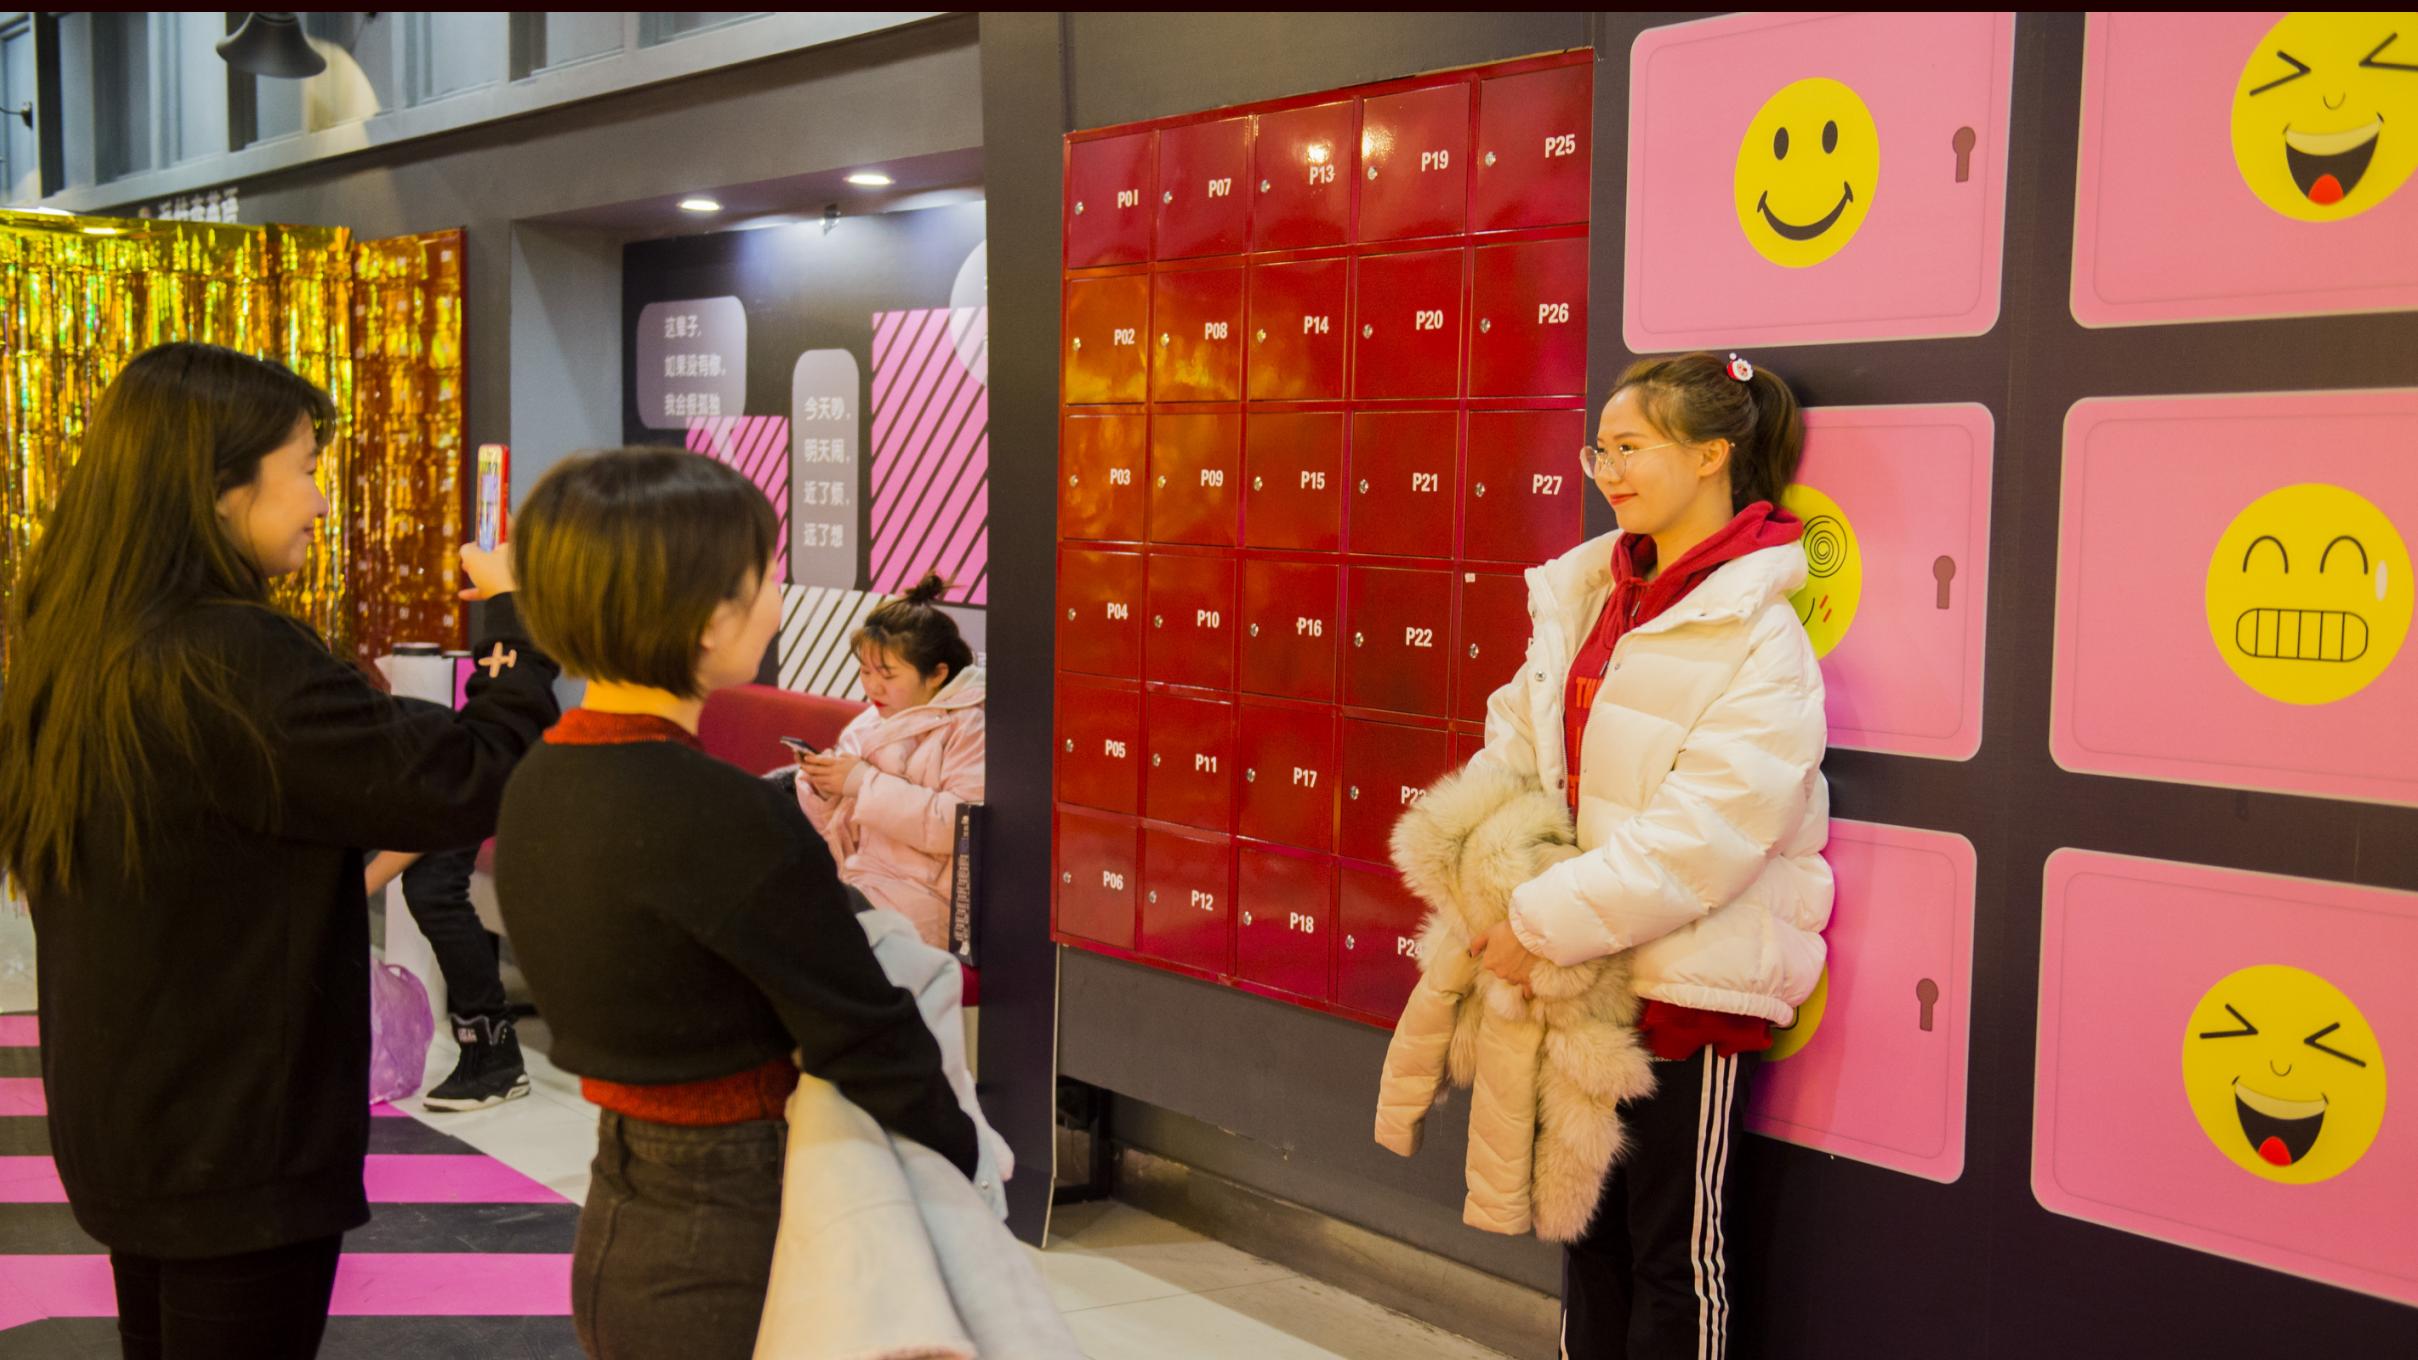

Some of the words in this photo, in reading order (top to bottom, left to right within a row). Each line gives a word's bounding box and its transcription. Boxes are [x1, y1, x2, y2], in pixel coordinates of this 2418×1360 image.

[1544, 133, 1576, 159] P25
[1421, 149, 1449, 172] P19
[1308, 163, 1337, 186] P13
[1208, 177, 1232, 198] P07
[1415, 309, 1444, 331] P20
[1538, 302, 1570, 325] P26
[1204, 321, 1228, 340] P08
[1303, 315, 1330, 335] P14
[1113, 327, 1136, 346] P02
[1109, 467, 1131, 486] P03
[1200, 468, 1224, 487] P09
[1300, 470, 1326, 490] P15
[1412, 472, 1438, 493] P21
[1532, 473, 1563, 496] P27
[1106, 601, 1129, 620] P04
[1196, 609, 1220, 629] P10
[1296, 616, 1323, 638] P16
[1405, 626, 1433, 648] P22
[1104, 739, 1126, 759] P05
[1195, 753, 1217, 773] P11
[1293, 766, 1318, 788] P17
[1102, 870, 1124, 891] P06
[1191, 889, 1214, 912] P12
[1289, 911, 1315, 934] P18
